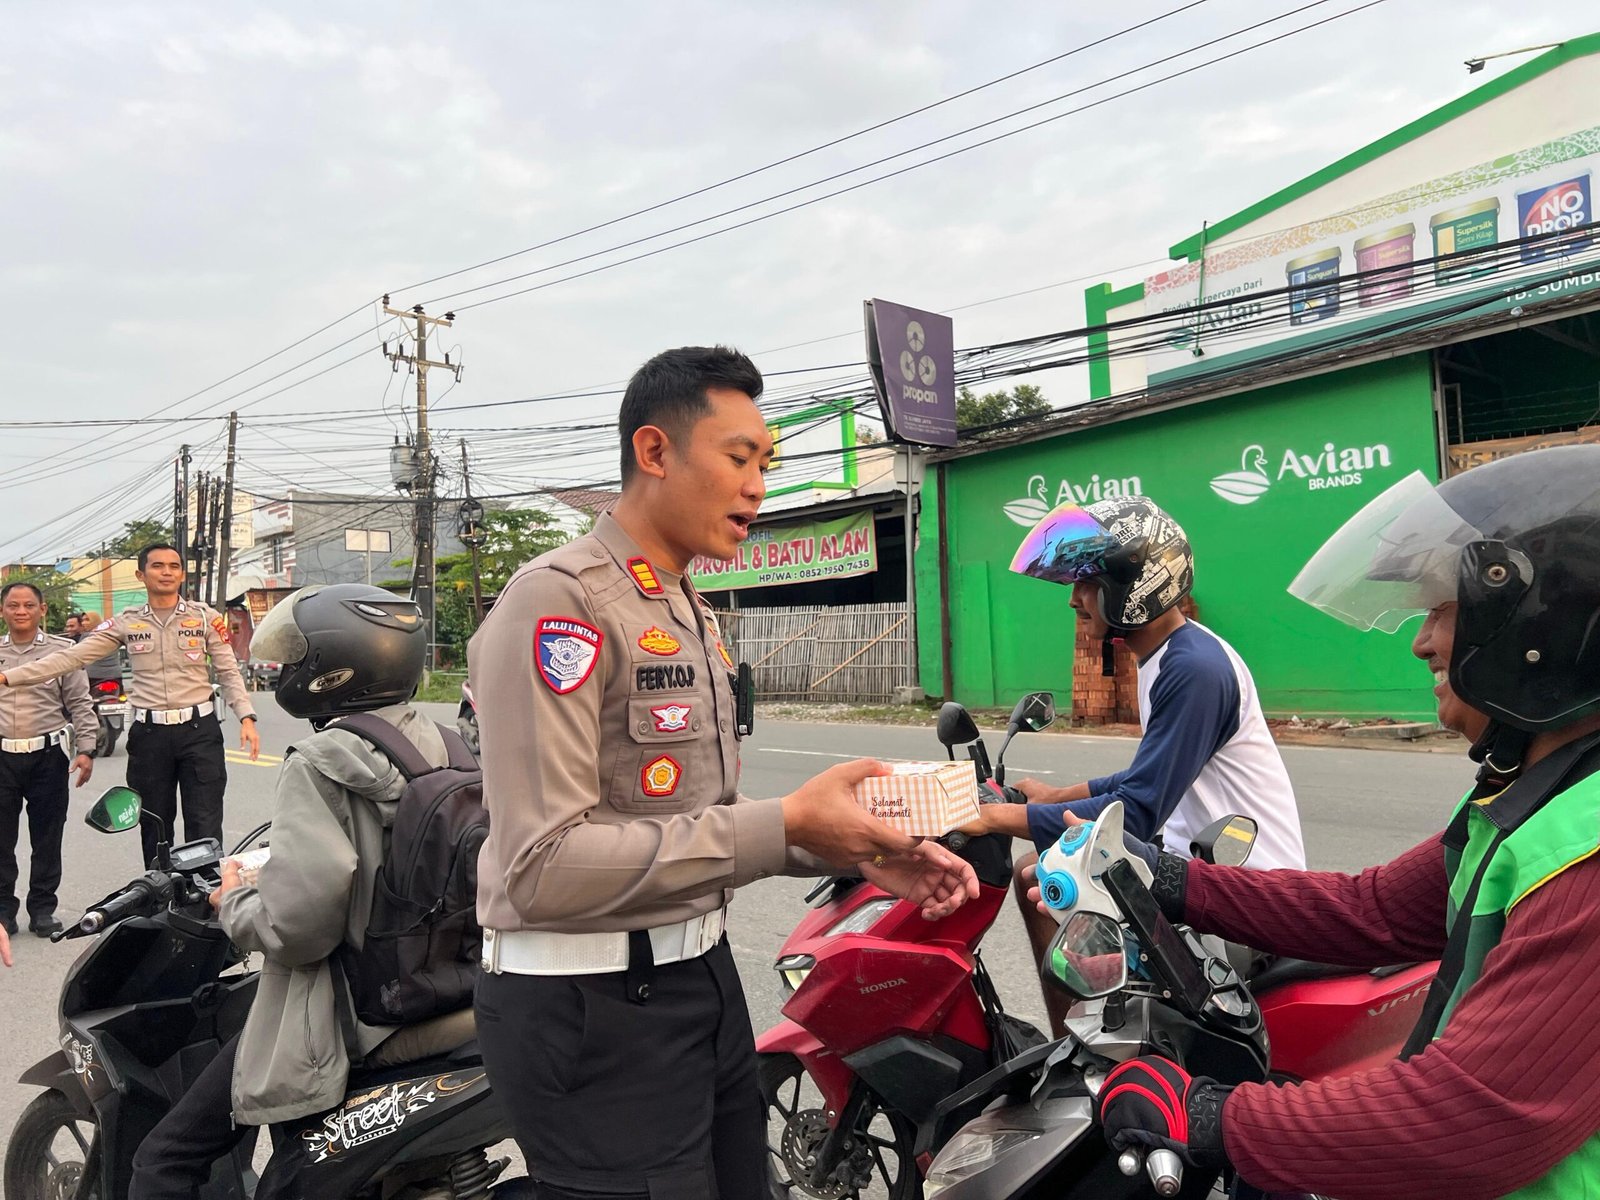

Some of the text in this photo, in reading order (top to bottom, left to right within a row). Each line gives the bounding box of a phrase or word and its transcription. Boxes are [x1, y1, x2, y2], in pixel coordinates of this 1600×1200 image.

[1541, 190, 1584, 219] NO
[1457, 220, 1493, 236] Supersilk
[1527, 211, 1585, 236] DROP
[1244, 278, 1262, 291] Dari
[903, 384, 938, 404] propan
[1277, 442, 1391, 480] Avian
[1055, 474, 1143, 505] Avian
[1308, 472, 1362, 490] BRANDS
[752, 546, 763, 570] &
[767, 538, 814, 568] BATU
[819, 527, 869, 562] ALAM
[759, 571, 792, 583] HP/WA
[799, 568, 822, 579] 0852
[824, 564, 845, 576] 1950
[847, 559, 870, 570] 7438
[127, 633, 152, 641] RYAN
[178, 629, 204, 637] POLRI
[542, 621, 599, 642] LALU LINTAS
[871, 796, 904, 807] Selamat
[860, 978, 907, 994] HONDA
[323, 1084, 406, 1149] Street
